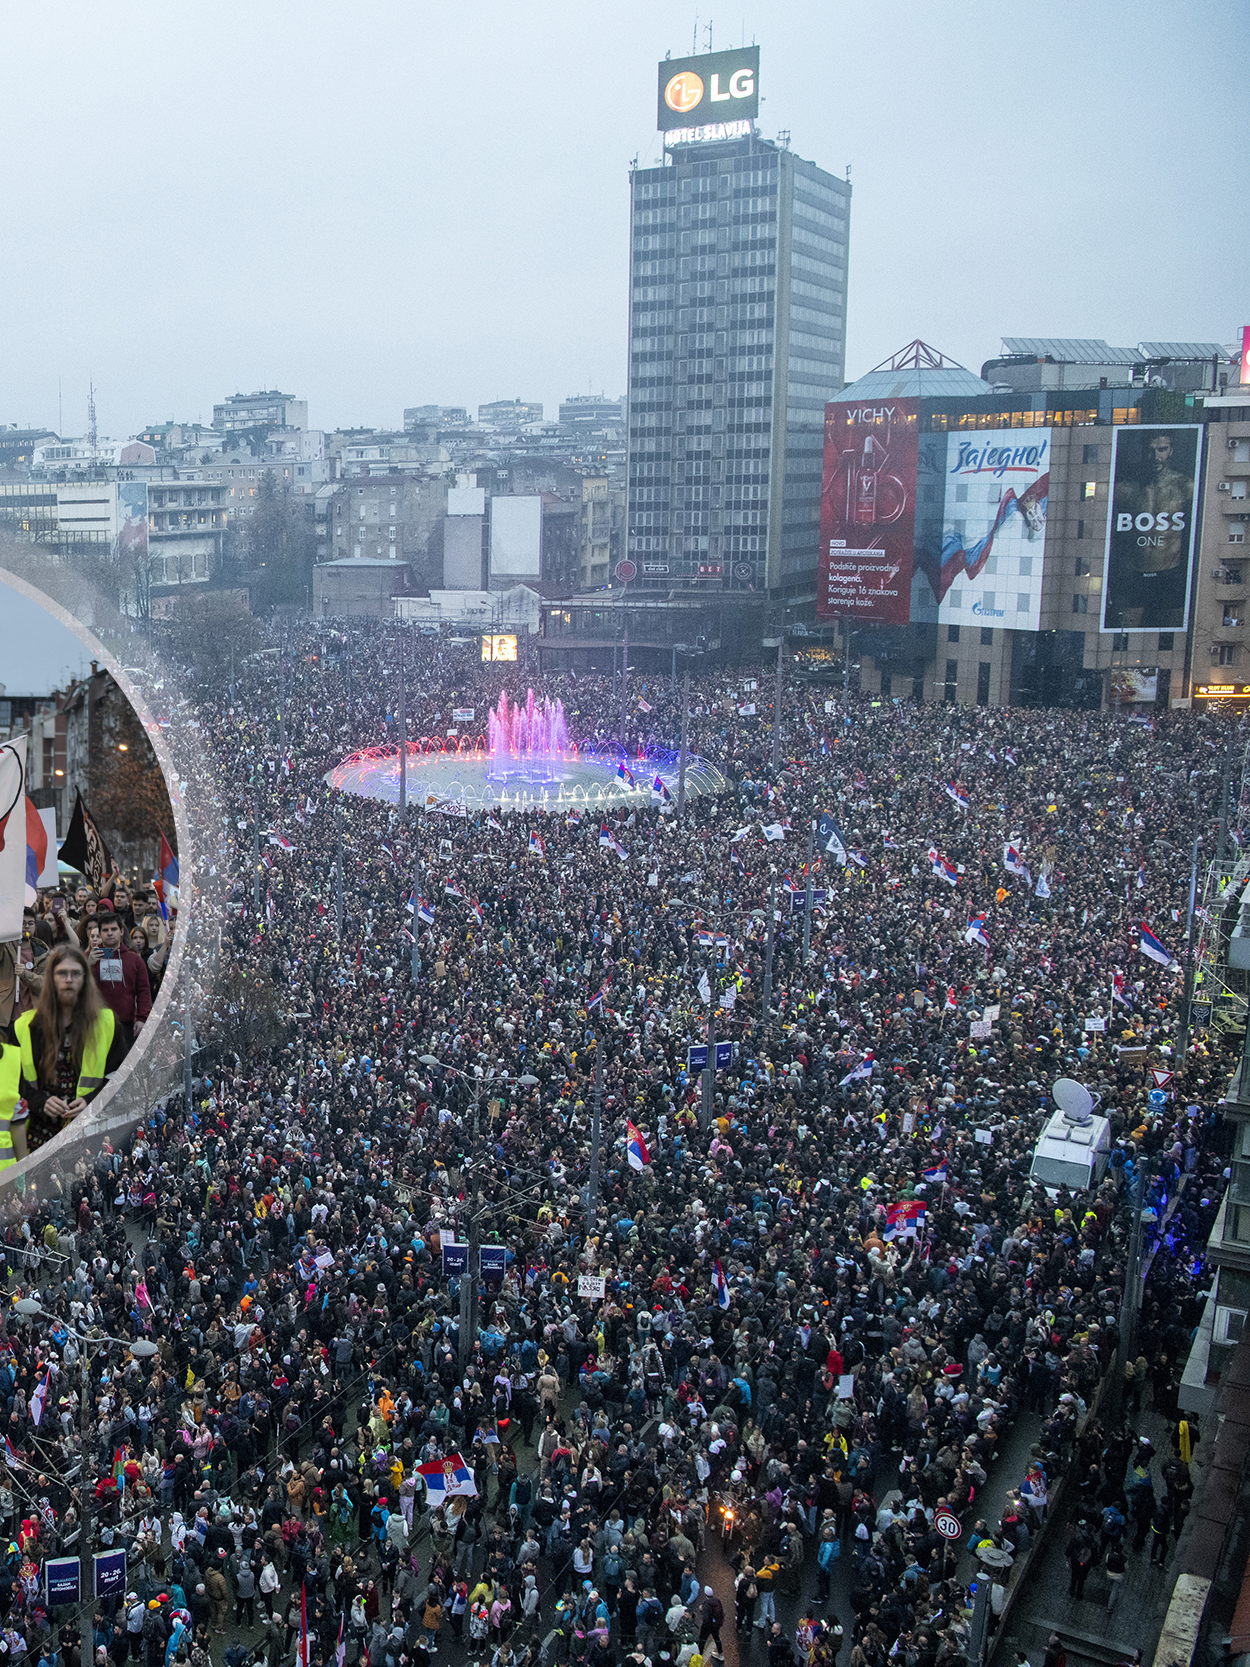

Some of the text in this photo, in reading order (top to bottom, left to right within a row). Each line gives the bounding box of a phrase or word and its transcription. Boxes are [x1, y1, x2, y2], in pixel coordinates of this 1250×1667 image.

[710, 68, 754, 102] LG
[664, 119, 751, 148] HOTEL SLAVIJA
[847, 407, 896, 423] VICHY
[1116, 511, 1186, 532] BOSS
[1136, 535, 1165, 547] ONE
[829, 561, 857, 571] Podstiče
[859, 585, 867, 594] 16
[868, 587, 898, 596] znakova
[940, 1518, 956, 1534] 30
